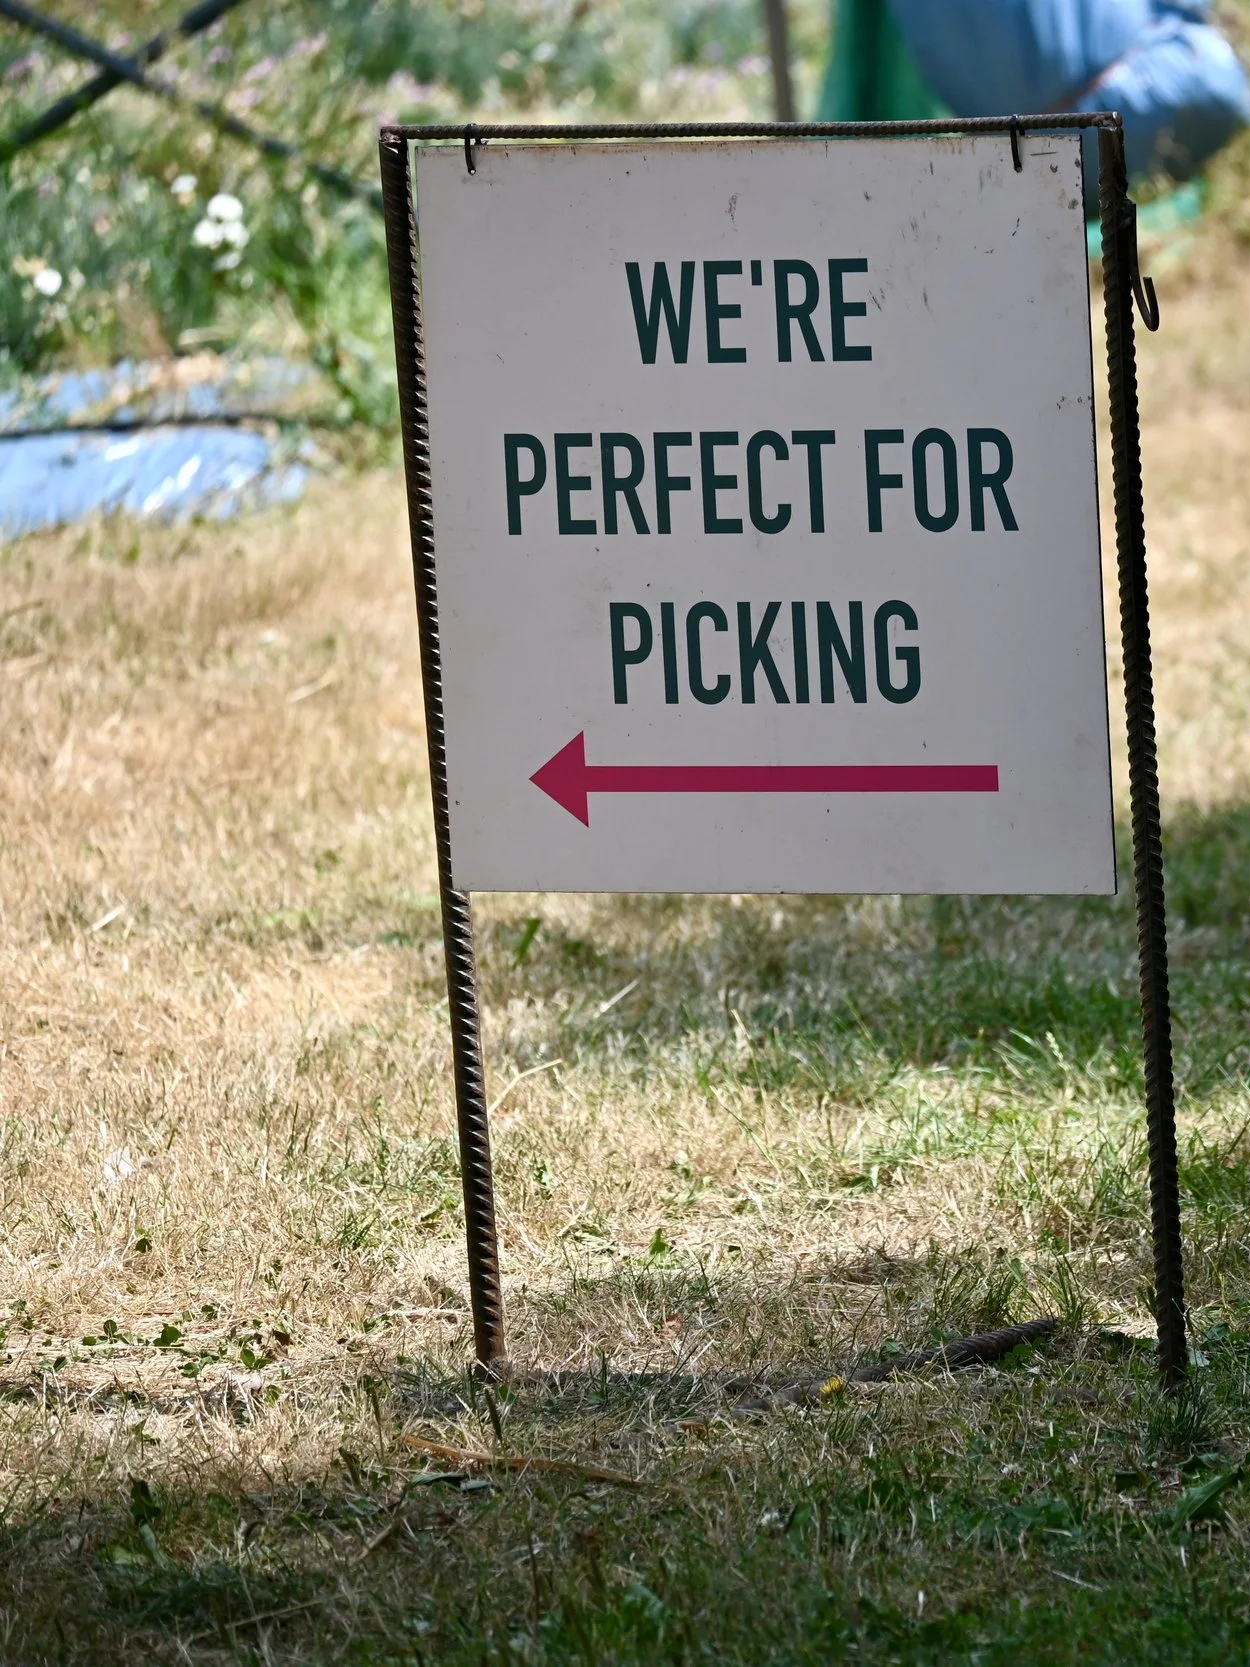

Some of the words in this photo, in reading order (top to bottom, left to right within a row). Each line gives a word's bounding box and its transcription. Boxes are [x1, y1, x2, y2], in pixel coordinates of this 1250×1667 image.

[625, 258, 873, 365] WE'RE
[504, 430, 836, 536] PERFECT
[863, 427, 1020, 533] FOR
[608, 600, 922, 705] PICKING
